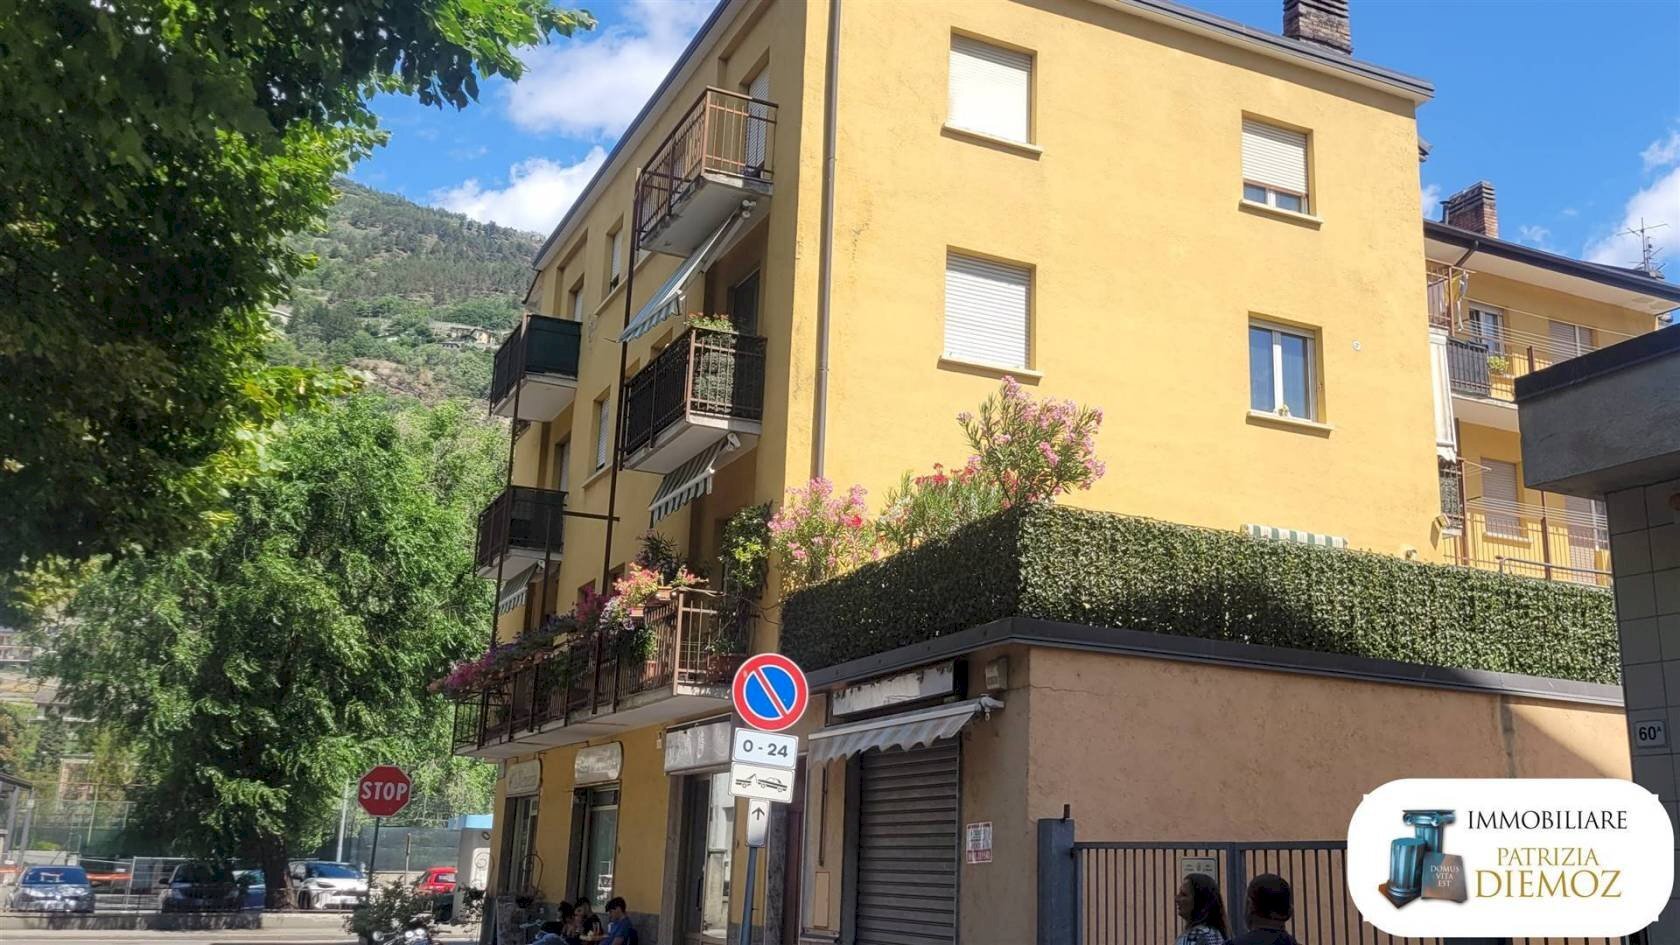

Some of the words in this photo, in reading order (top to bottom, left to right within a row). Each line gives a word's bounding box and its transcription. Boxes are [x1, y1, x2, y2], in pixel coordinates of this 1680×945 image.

[743, 739, 752, 752] 0
[767, 743, 788, 757] 24
[361, 781, 408, 801] STOP
